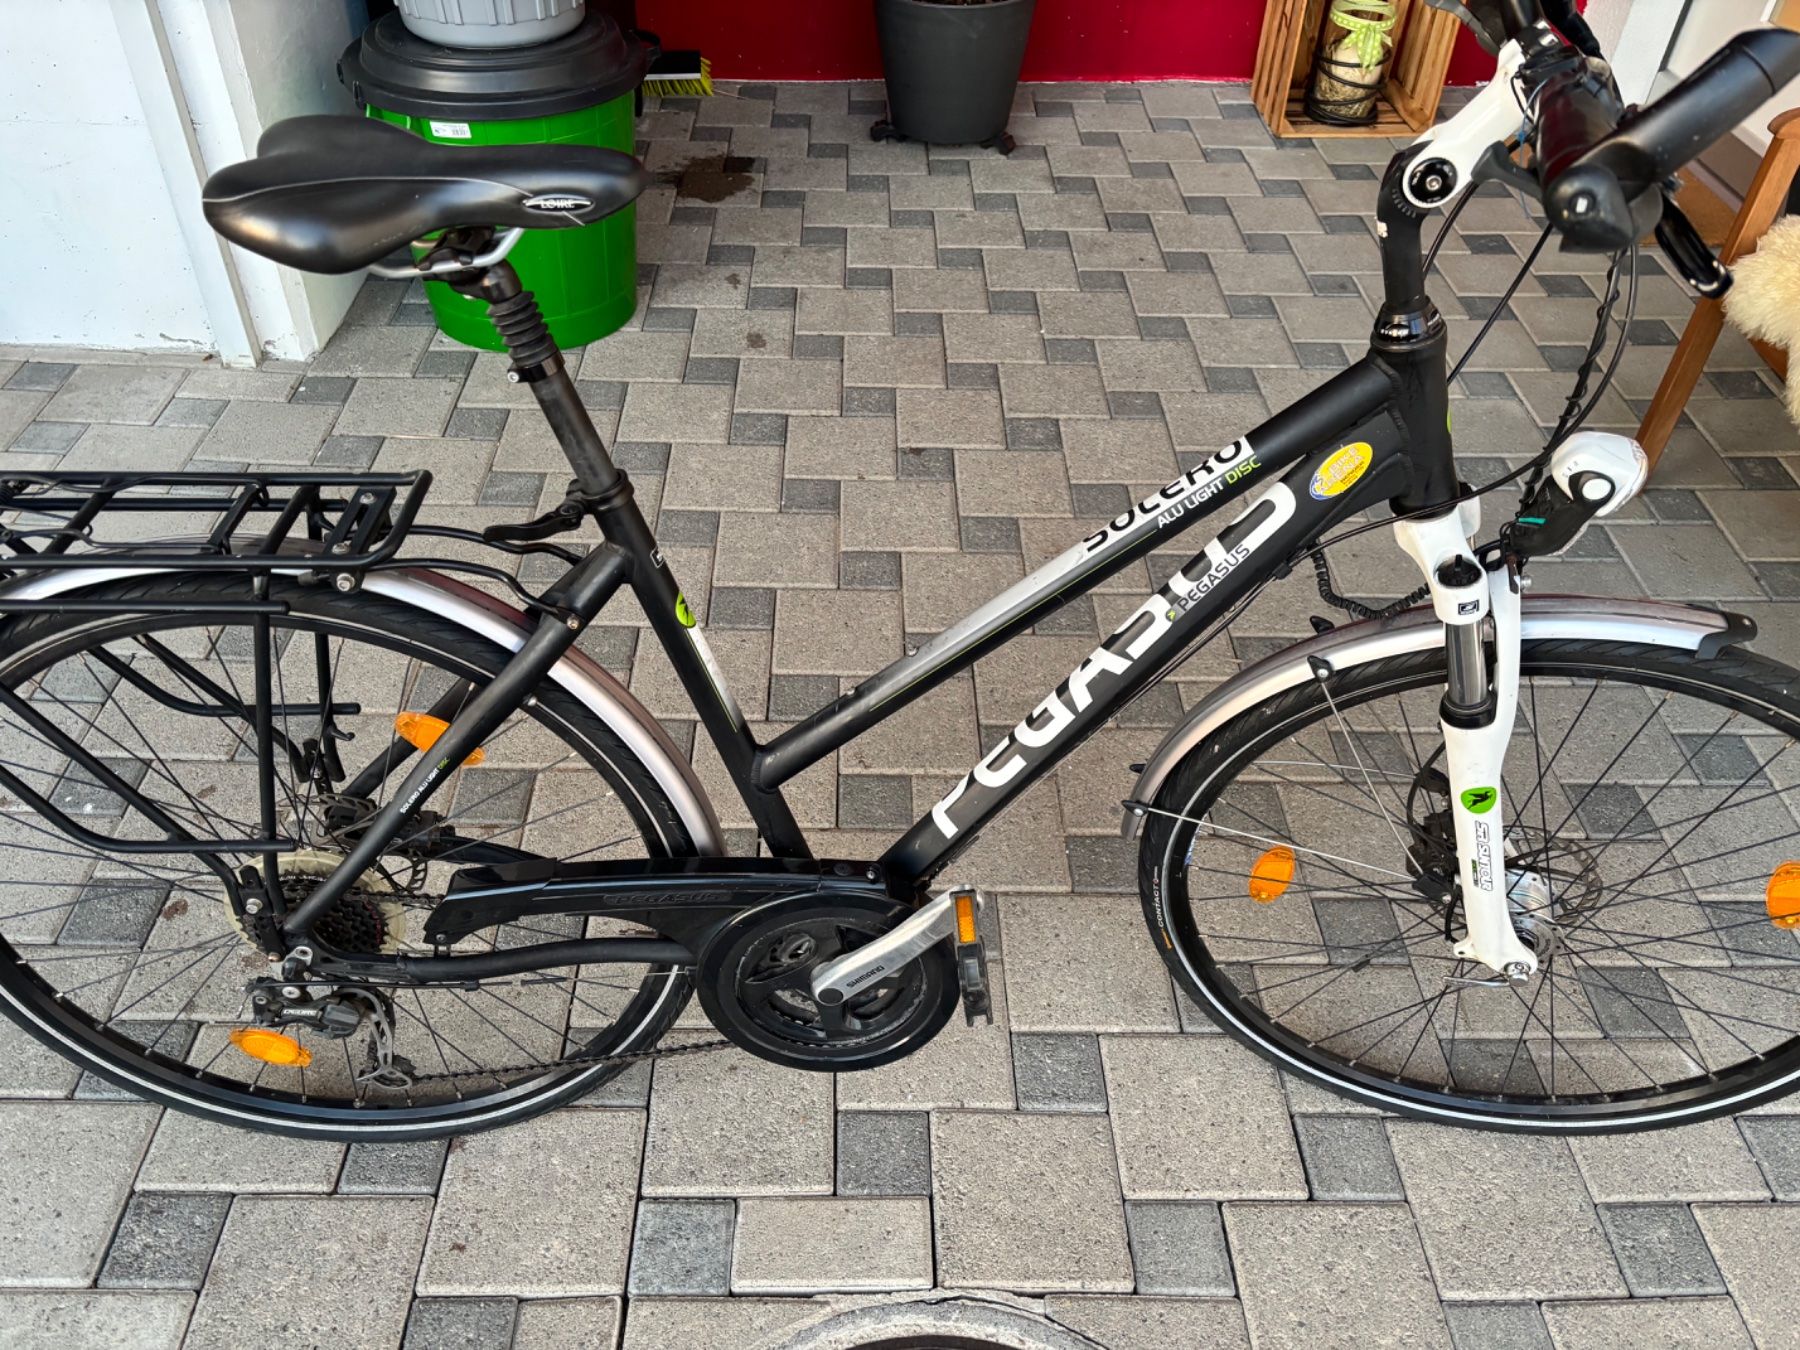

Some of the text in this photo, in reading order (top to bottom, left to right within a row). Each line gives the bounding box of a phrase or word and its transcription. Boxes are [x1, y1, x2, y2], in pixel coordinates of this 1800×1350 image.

[1157, 455, 1262, 529] ALU LIGHT DISC
[1177, 544, 1250, 612] PEGASUS
[932, 482, 1296, 839] PEGASUS
[400, 791, 421, 813] SOLERO
[418, 781, 428, 793] ALU
[426, 767, 440, 783] LIGHT
[1475, 820, 1490, 843] SR
[1477, 842, 1494, 892] SUNTOUR
[1152, 882, 1164, 928] CONTACT
[846, 964, 886, 988] SHIMANO
